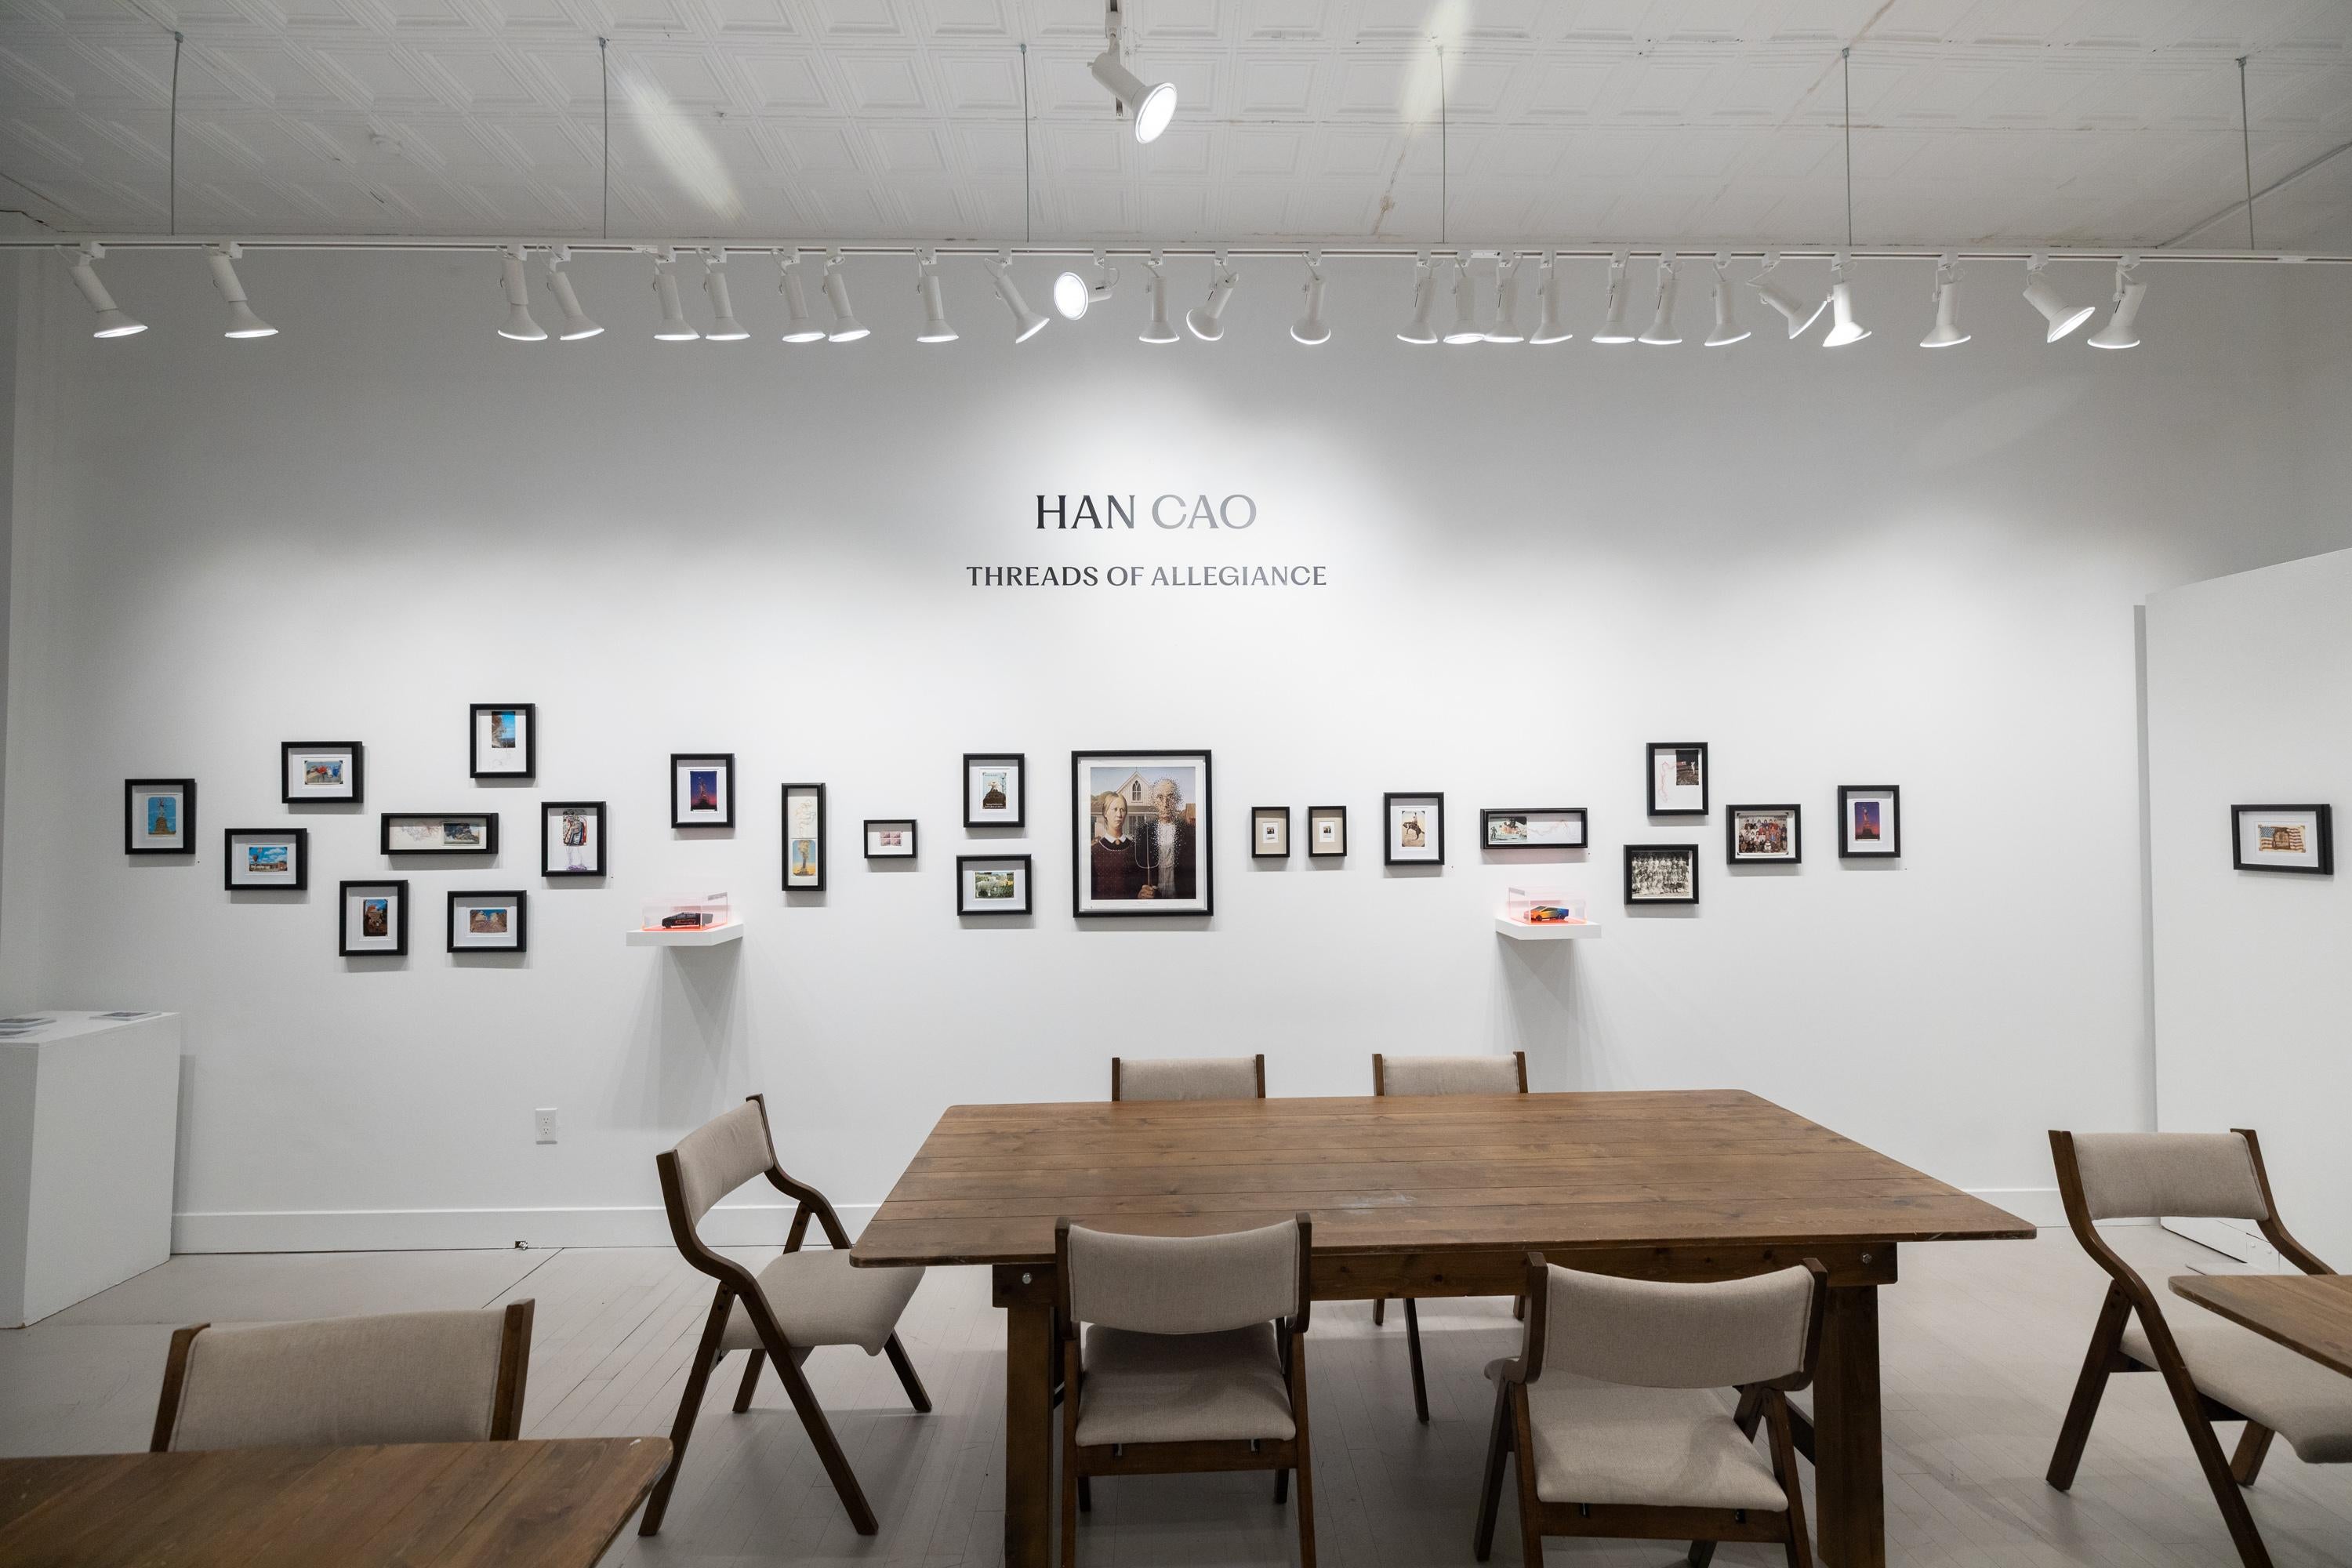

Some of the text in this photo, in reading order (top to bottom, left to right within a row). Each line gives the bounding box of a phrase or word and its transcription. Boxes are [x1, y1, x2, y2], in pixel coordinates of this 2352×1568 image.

[1036, 494, 1256, 529] HAN CAO
[966, 565, 1327, 587] THREADS OF ALLEGIANCE
